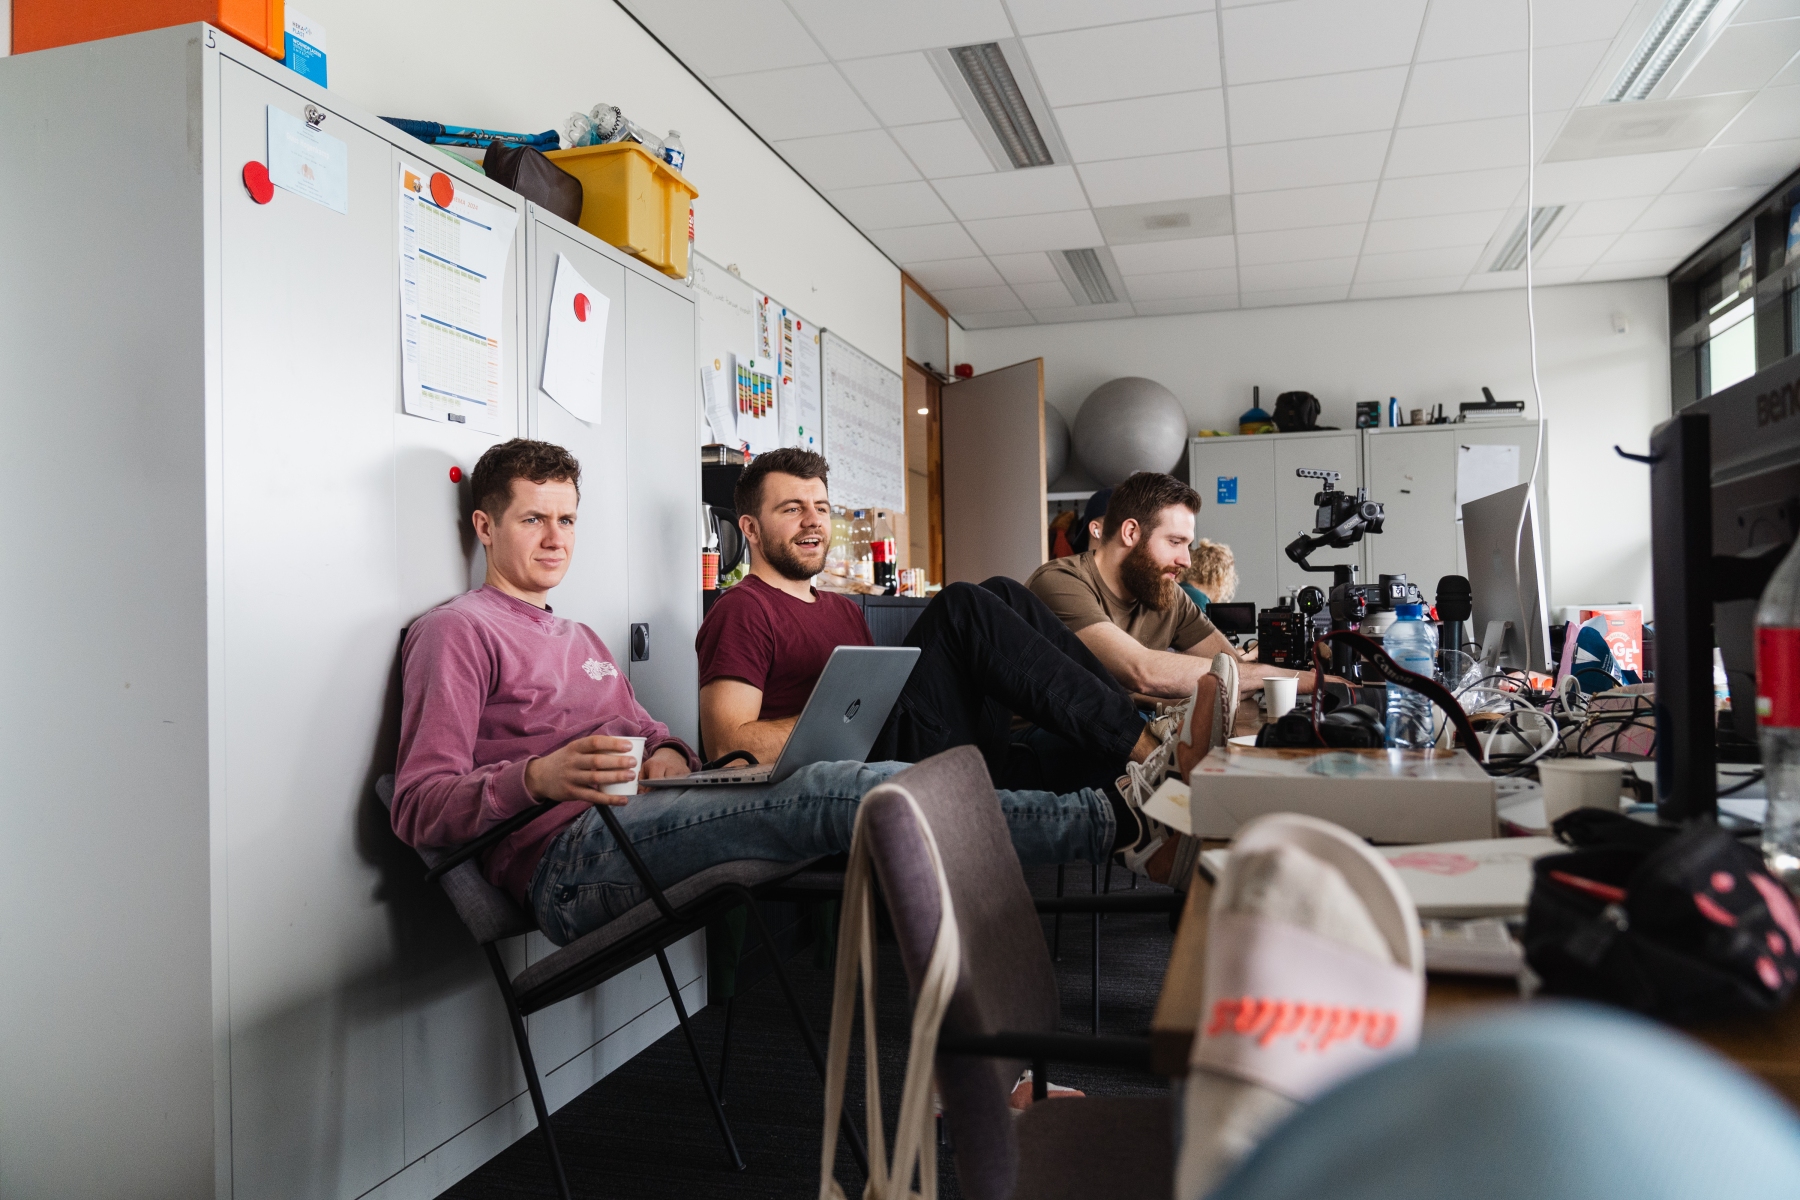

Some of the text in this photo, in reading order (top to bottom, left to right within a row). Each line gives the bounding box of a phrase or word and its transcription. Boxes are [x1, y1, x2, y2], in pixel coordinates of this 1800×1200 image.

[205, 29, 216, 49] 5
[1373, 653, 1414, 684] Canon
[1208, 995, 1397, 1050] adidas
